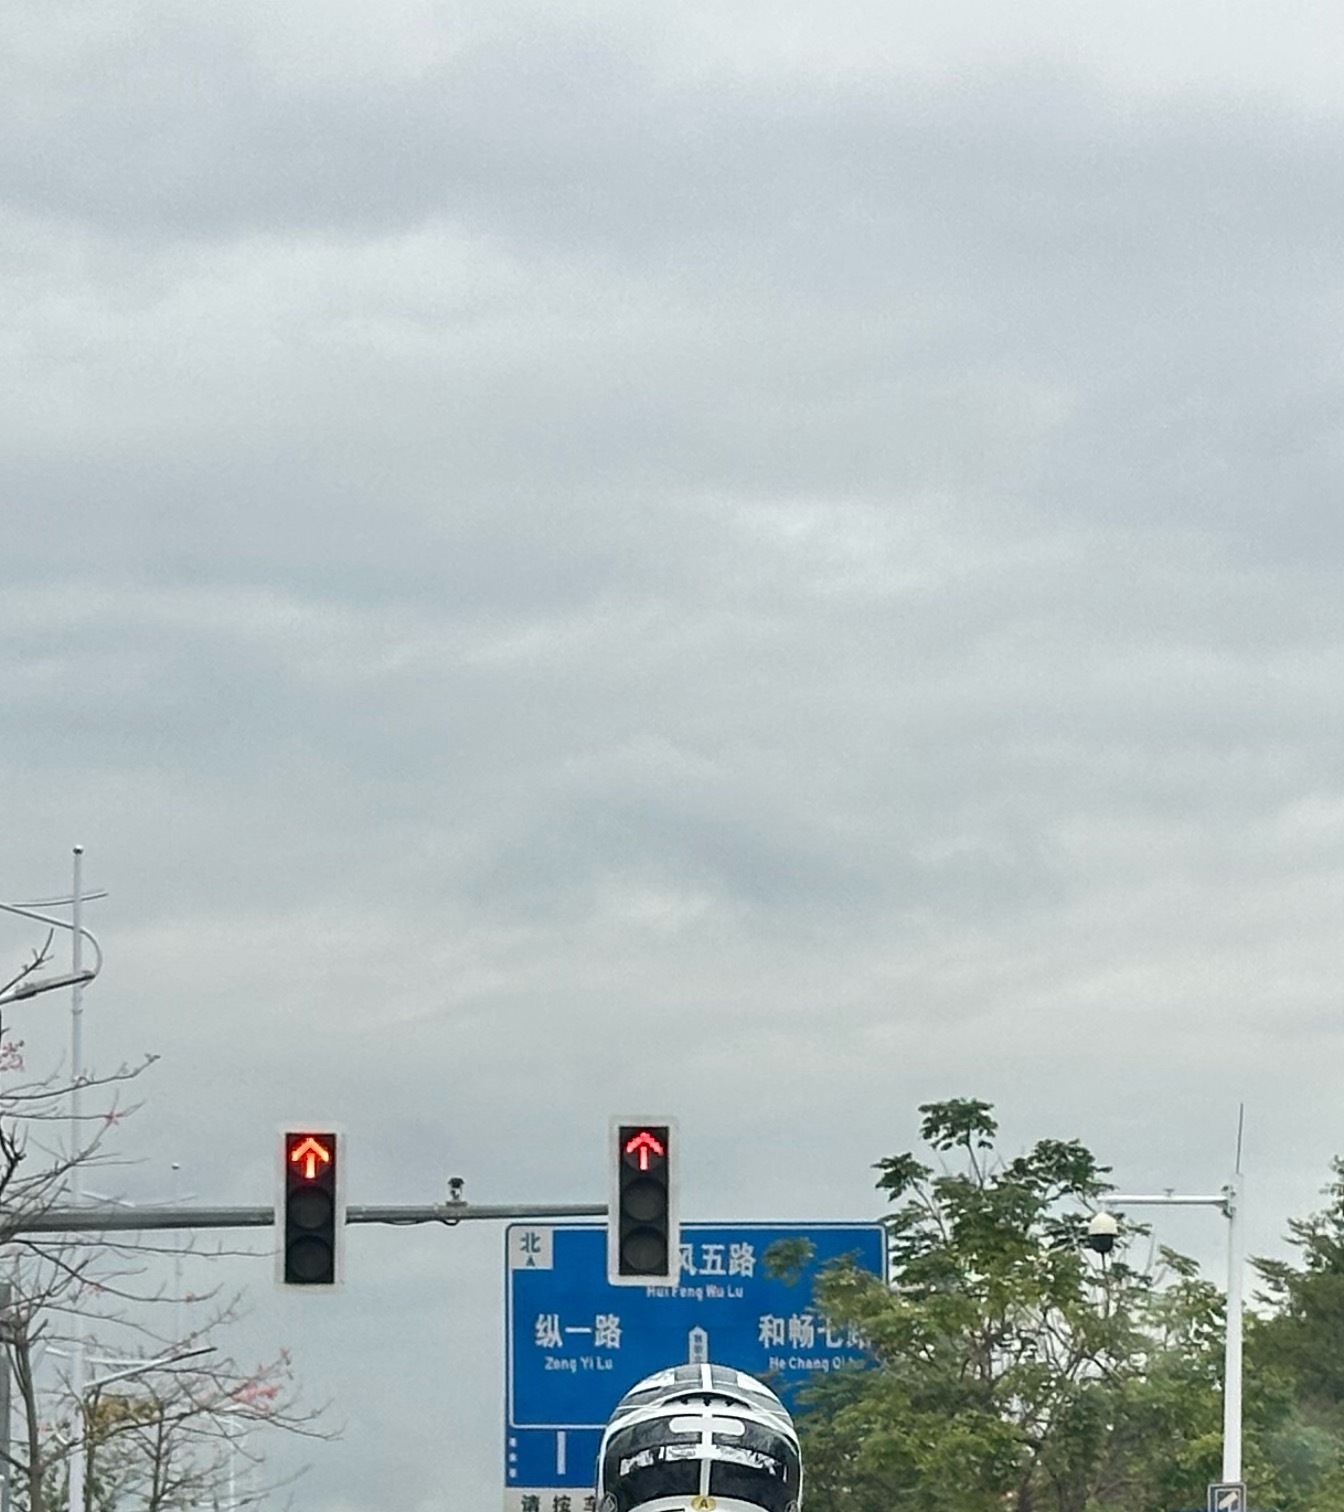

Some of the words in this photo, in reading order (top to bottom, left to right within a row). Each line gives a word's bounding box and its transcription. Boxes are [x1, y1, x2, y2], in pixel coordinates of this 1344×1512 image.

[520, 1232, 541, 1253] 北
[679, 1242, 757, 1278] 风五路
[706, 1284, 725, 1298] Wu
[728, 1284, 744, 1298] Lu
[535, 1313, 623, 1349] 纵一路
[580, 1356, 594, 1370] Yi
[597, 1356, 613, 1370] Lu
[769, 1357, 786, 1370] He
[788, 1356, 830, 1373] Chang
